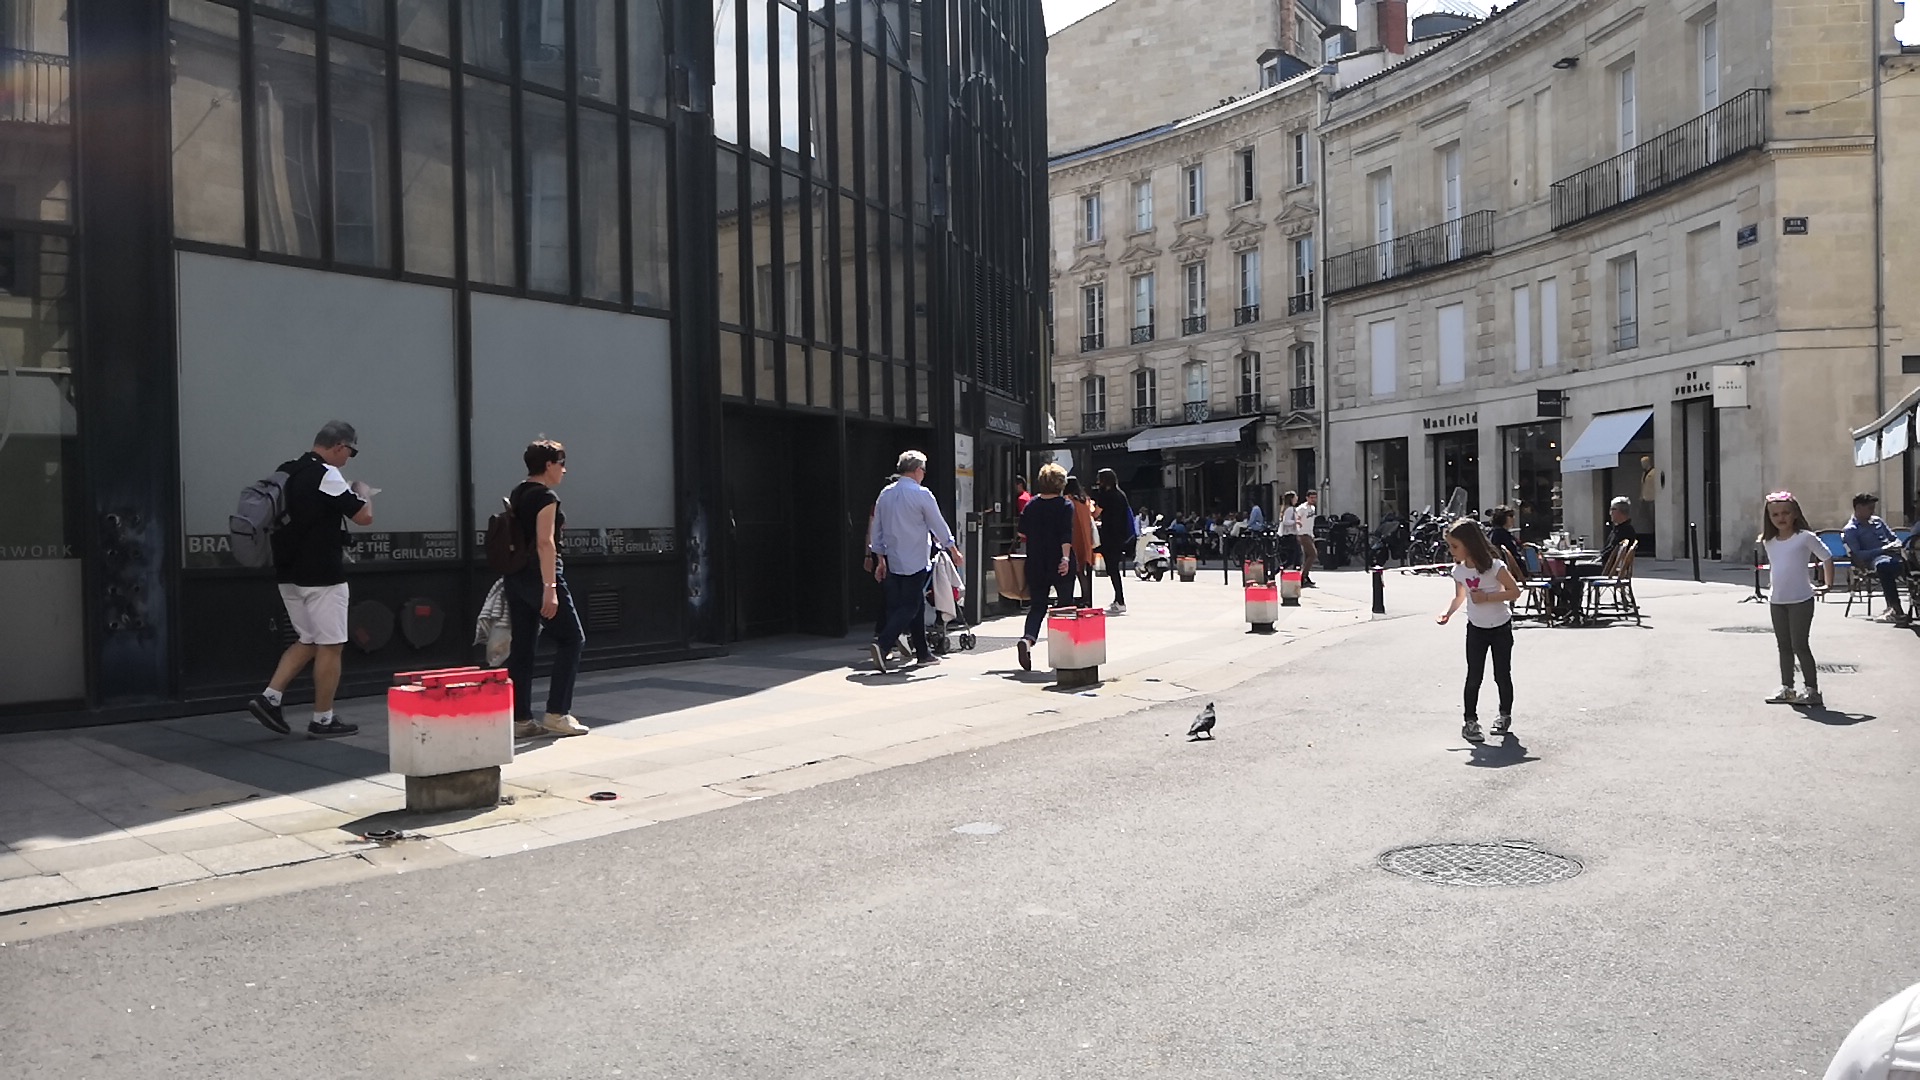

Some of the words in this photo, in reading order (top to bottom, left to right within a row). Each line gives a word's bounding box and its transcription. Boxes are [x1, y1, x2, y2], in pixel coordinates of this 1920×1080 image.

[1686, 371, 1697, 381] DE
[1675, 382, 1710, 395] FURSAC
[1423, 412, 1478, 429] Manfield
[366, 541, 391, 553] THE
[393, 548, 457, 560] GRILLADES
